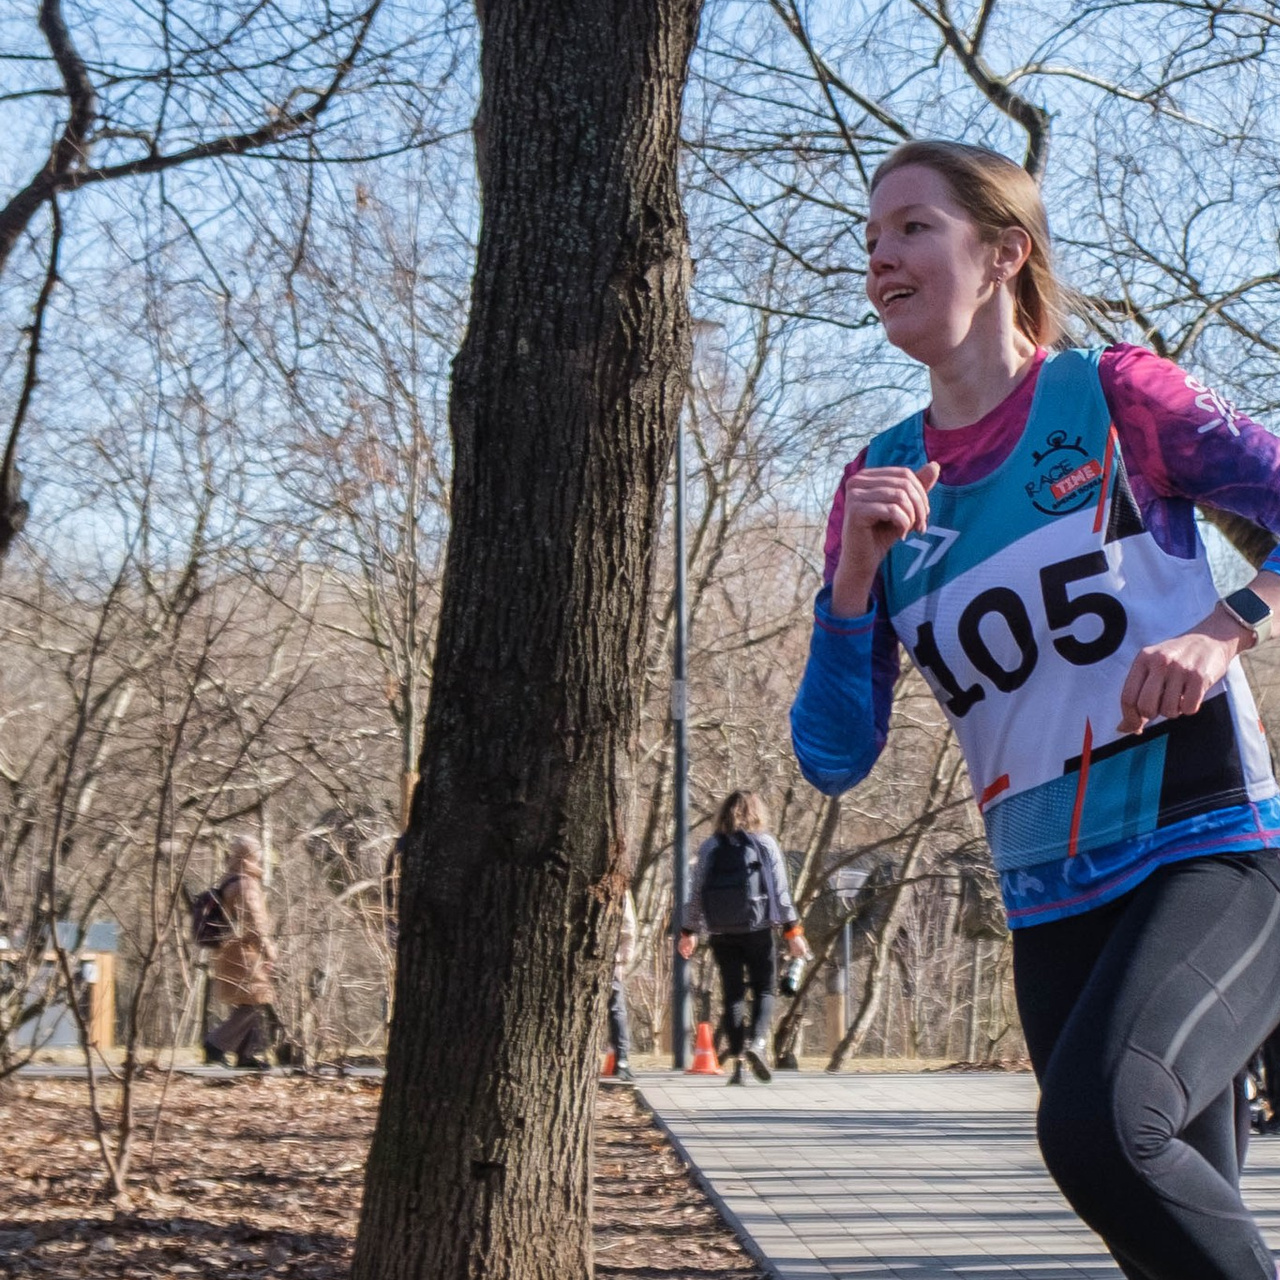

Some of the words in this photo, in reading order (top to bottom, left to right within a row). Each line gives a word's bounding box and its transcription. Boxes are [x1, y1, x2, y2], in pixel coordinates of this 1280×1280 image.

[1024, 458, 1074, 498] RACE
[1055, 464, 1096, 494] TIME
[913, 549, 1128, 718] 105
